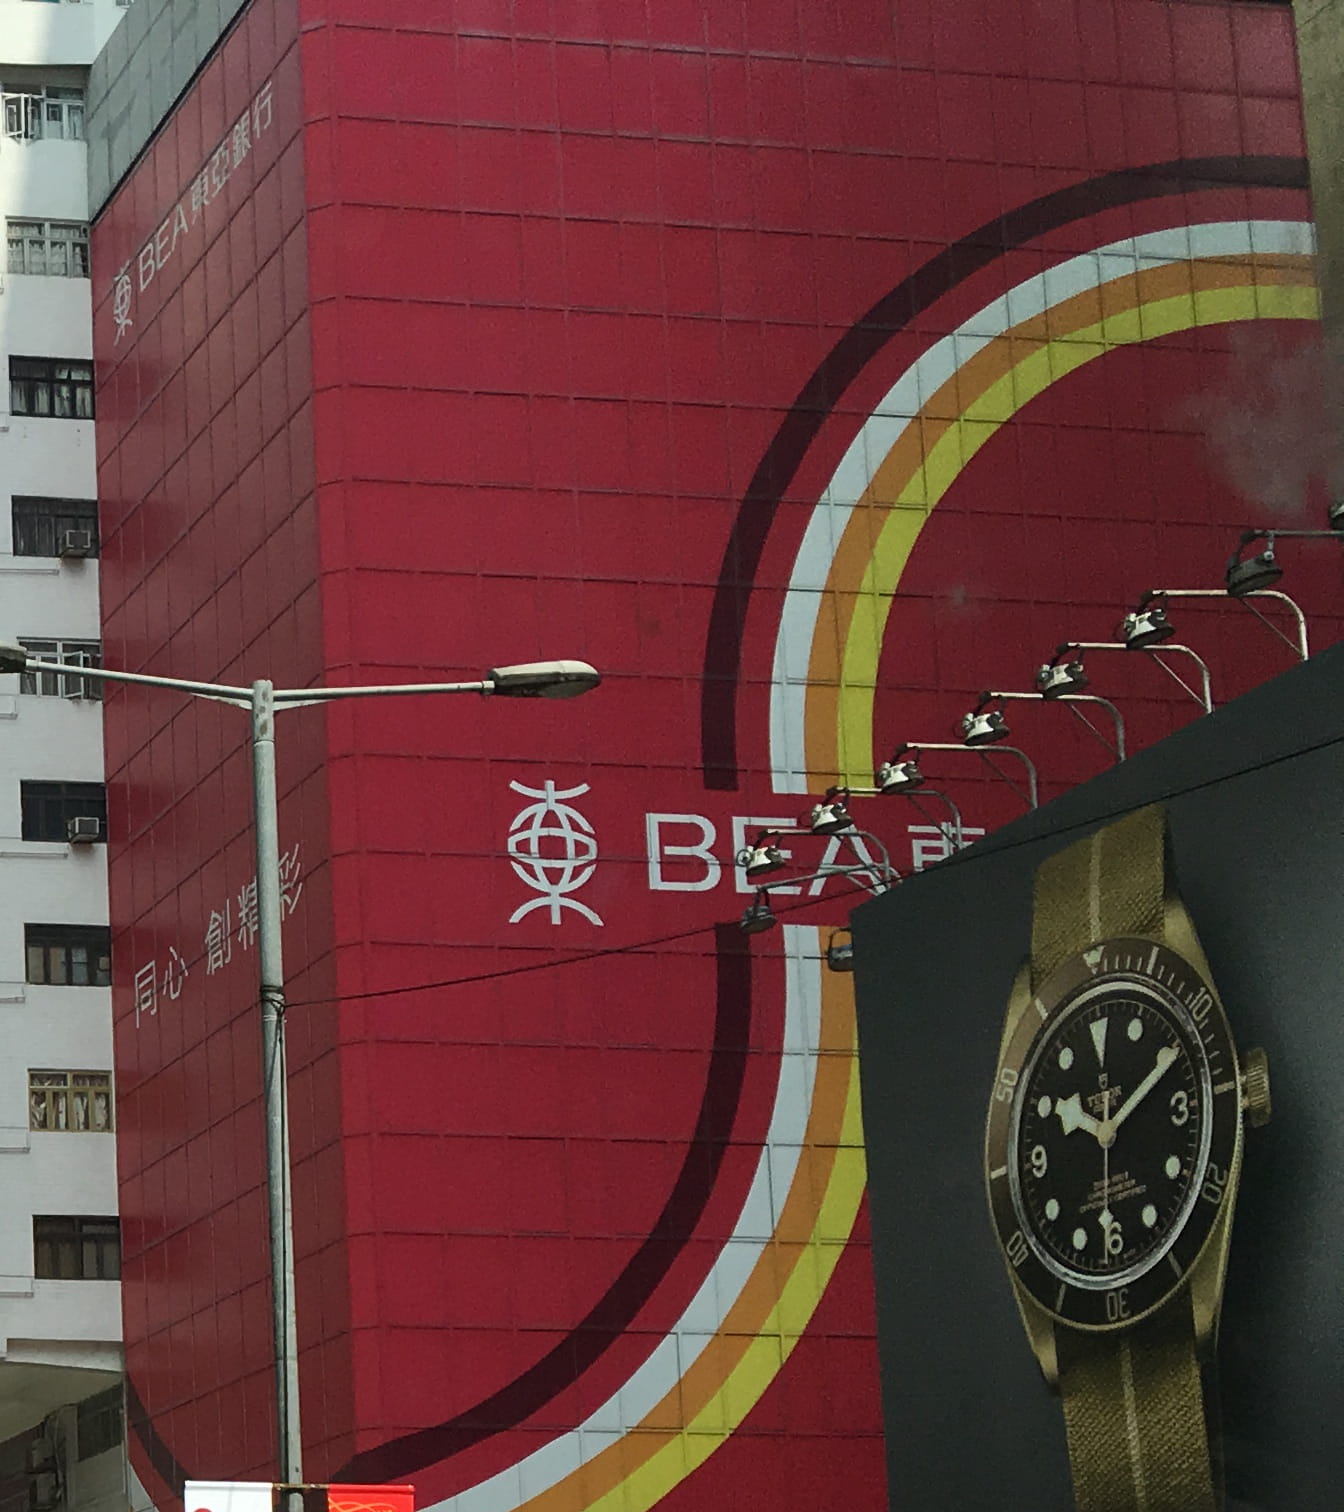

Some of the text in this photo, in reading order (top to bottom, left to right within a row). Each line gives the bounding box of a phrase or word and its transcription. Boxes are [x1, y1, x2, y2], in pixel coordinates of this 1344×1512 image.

[138, 81, 272, 293] BEA 東亞銀行
[646, 812, 903, 897] BEA
[135, 946, 188, 1029] 同心
[1171, 1091, 1189, 1126] 3
[1031, 1145, 1047, 1179] 9
[1109, 1220, 1124, 1255] 6
